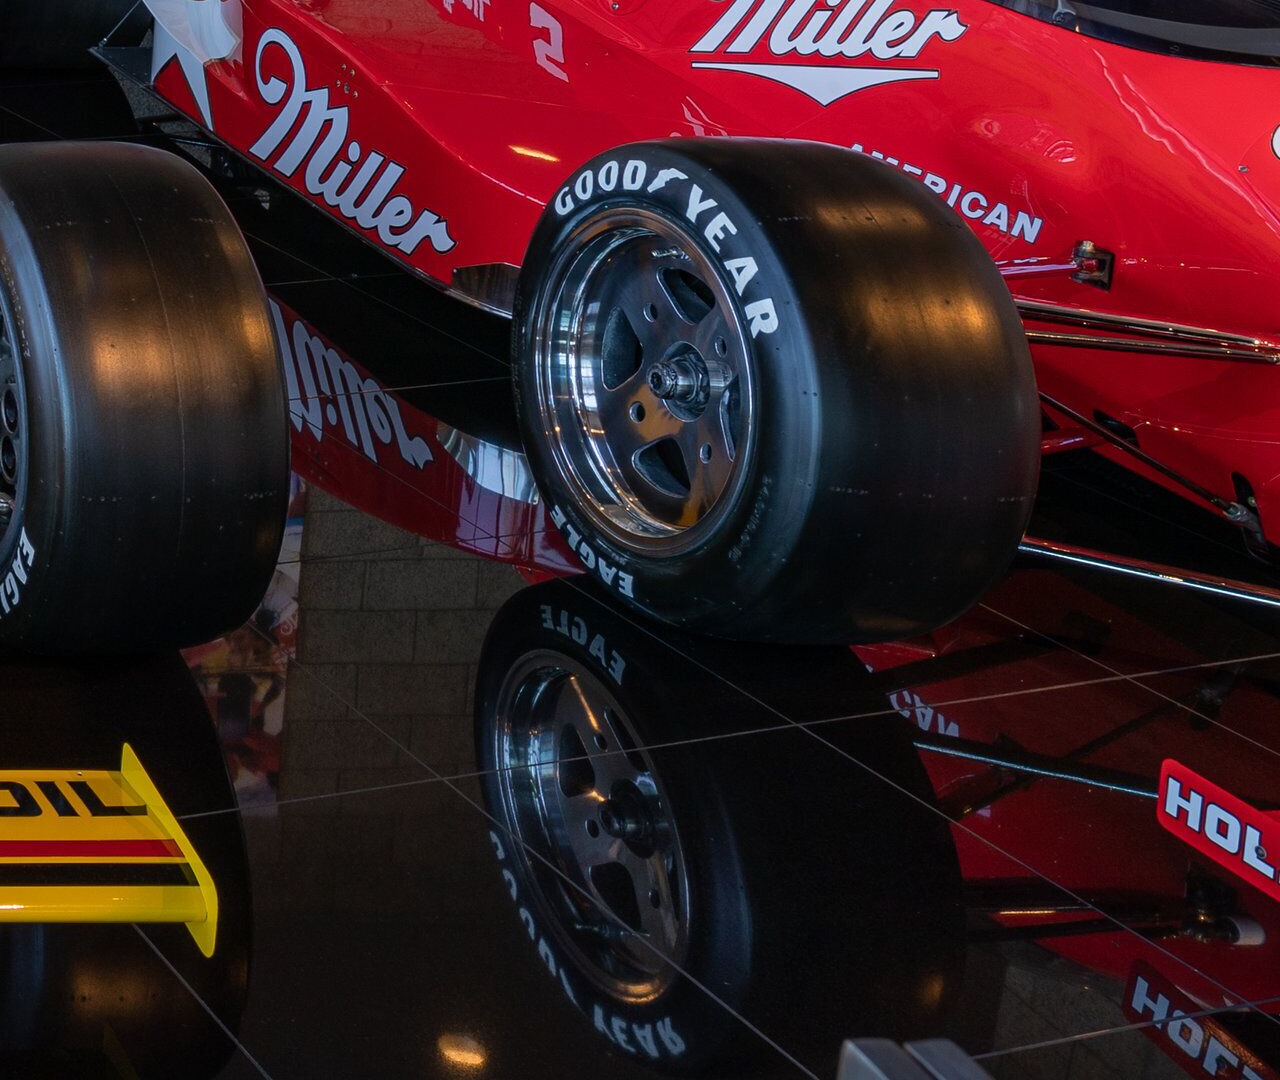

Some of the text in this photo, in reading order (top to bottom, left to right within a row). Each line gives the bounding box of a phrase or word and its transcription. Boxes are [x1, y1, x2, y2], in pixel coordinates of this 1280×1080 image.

[248, 26, 459, 258] Miller
[850, 143, 1043, 245] RICAN
[554, 159, 779, 340] GOODYEAR
[550, 504, 634, 599] EAGLE
[1164, 775, 1280, 885] HOL
